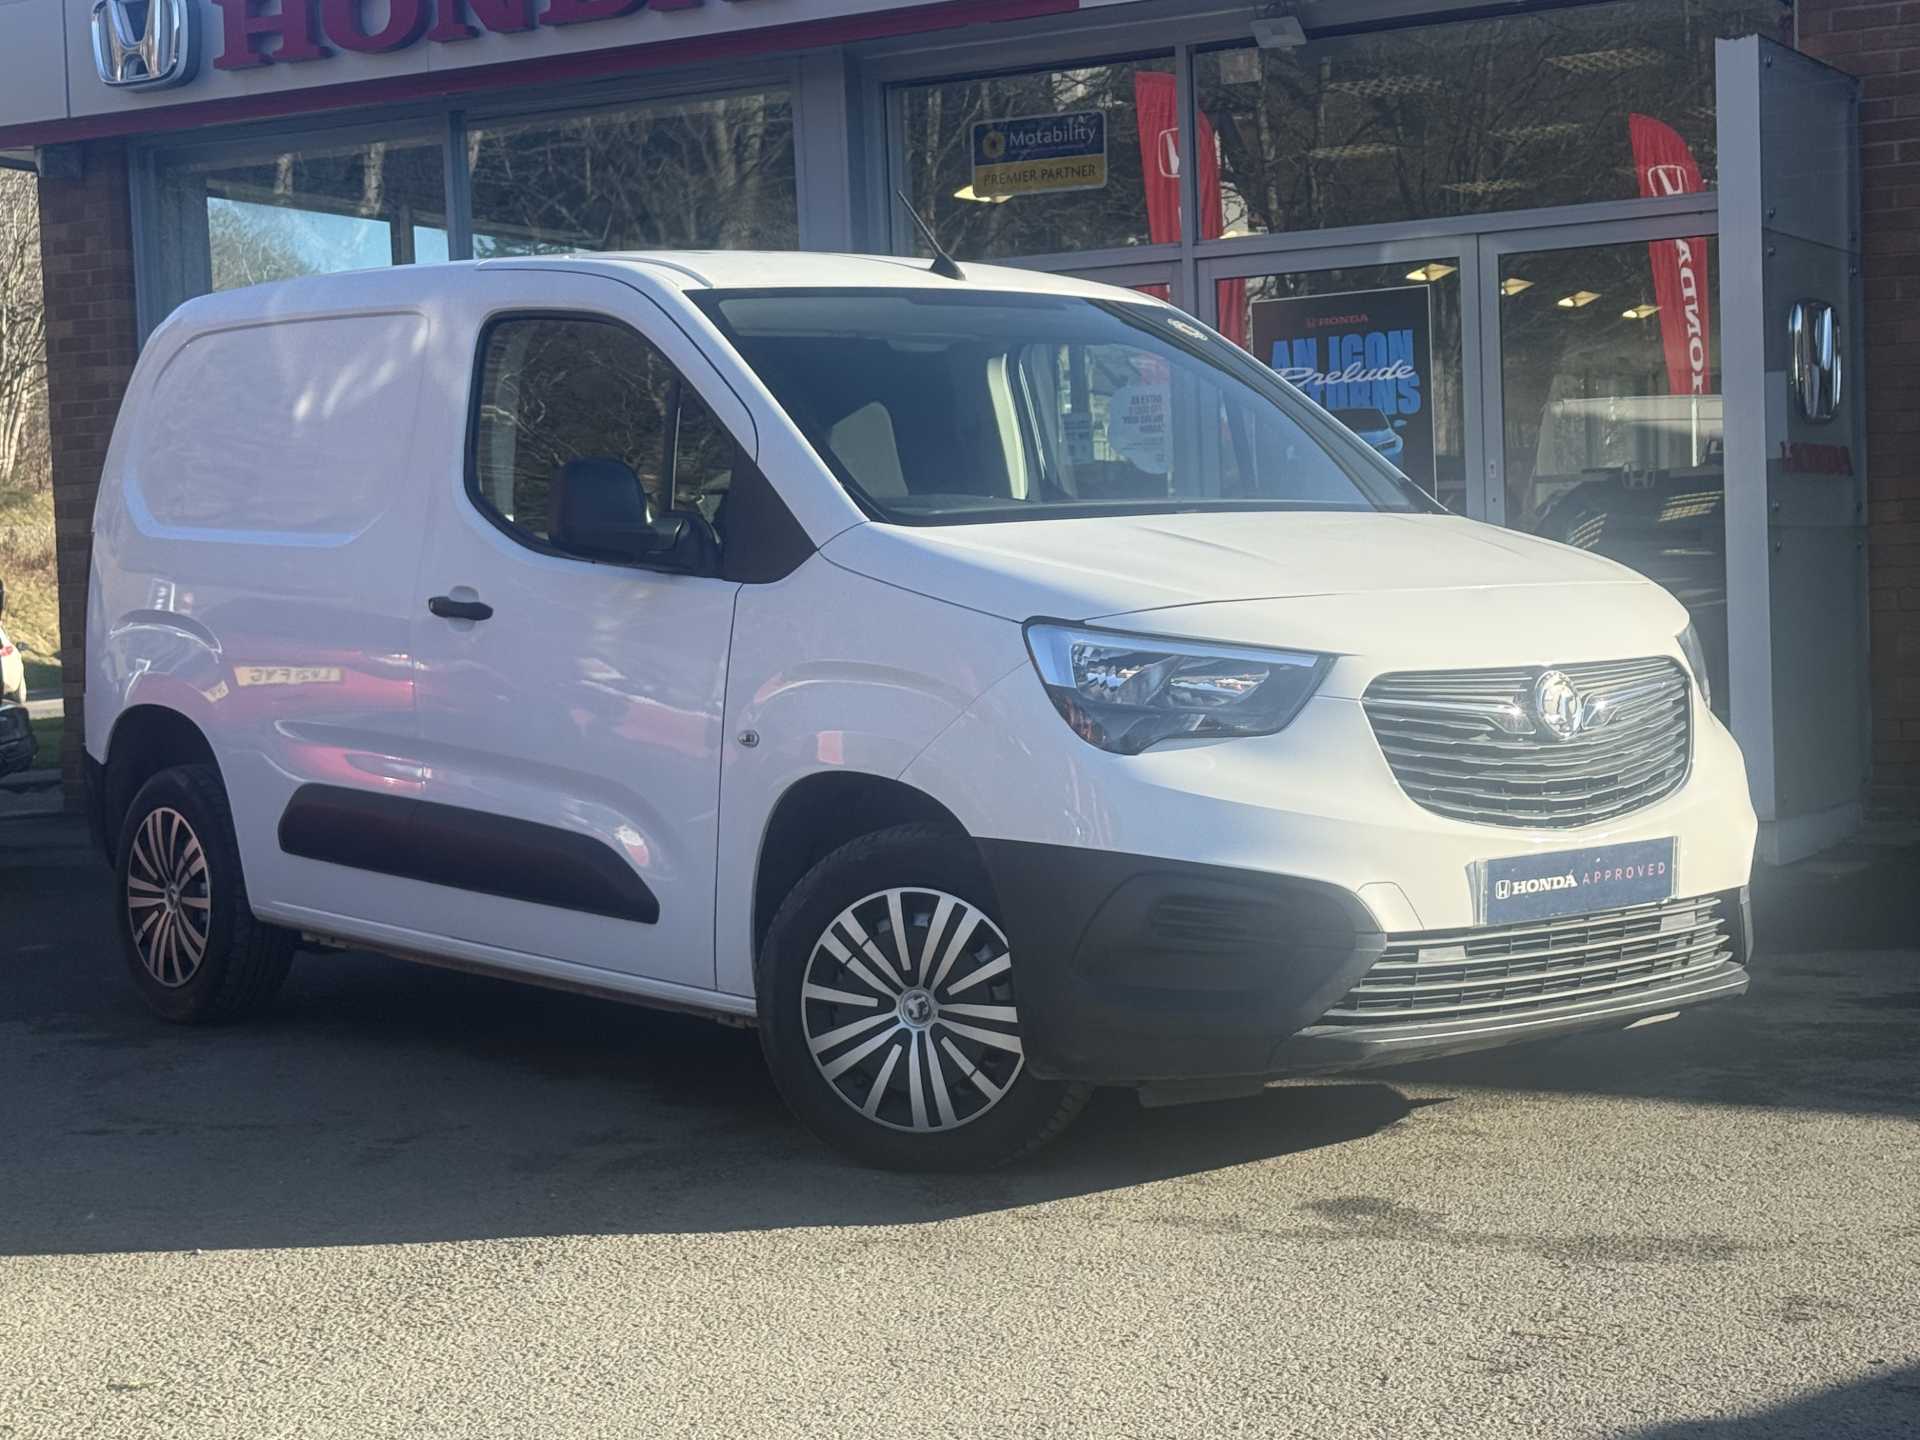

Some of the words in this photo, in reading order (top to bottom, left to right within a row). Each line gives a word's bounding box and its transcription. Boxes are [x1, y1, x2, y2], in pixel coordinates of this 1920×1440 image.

[212, 0, 770, 70] HON
[1009, 119, 1096, 146] Motability
[983, 169, 1037, 187] PREMIER
[1041, 163, 1096, 181] PARTNER
[1271, 337, 1318, 371] AN
[1328, 329, 1414, 372] ICON
[1273, 359, 1416, 388] Prelude
[1304, 375, 1422, 415] TURNS
[1511, 873, 1578, 895] HONDA
[1582, 861, 1667, 885] APPROVED
